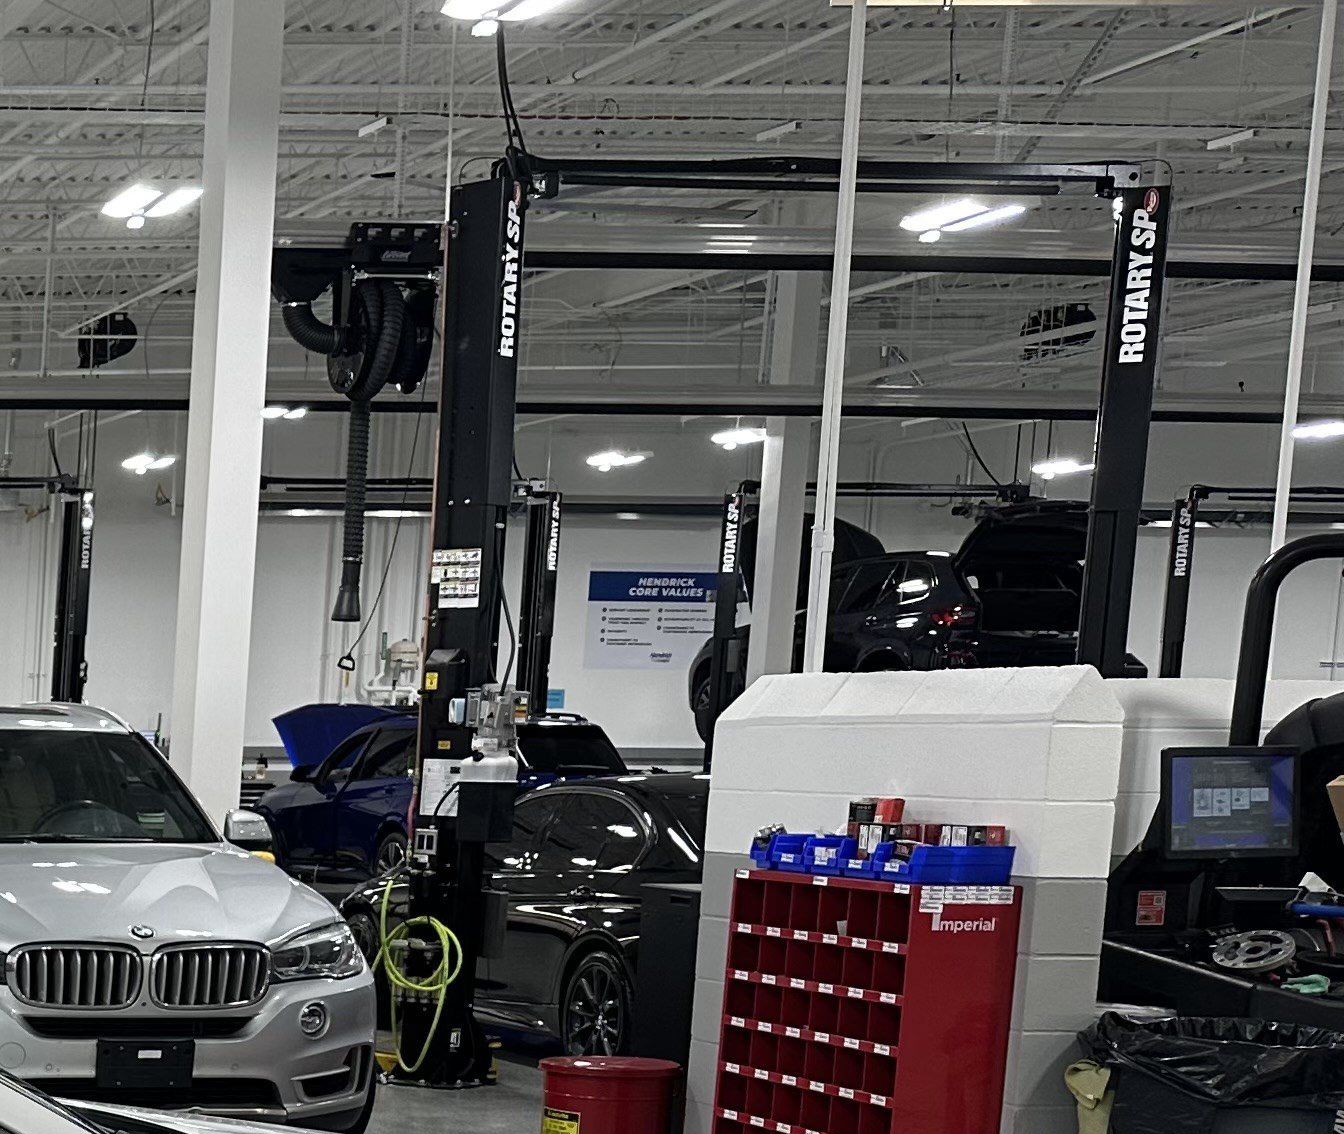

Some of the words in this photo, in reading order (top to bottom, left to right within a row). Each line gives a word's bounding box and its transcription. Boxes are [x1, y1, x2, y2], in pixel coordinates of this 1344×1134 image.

[507, 200, 520, 243] SP
[1131, 208, 1157, 249] SP
[500, 242, 518, 358] ROTARY
[1119, 251, 1154, 363] ROTARY
[727, 503, 739, 521] SP
[1179, 508, 1191, 526] SP
[548, 520, 559, 570] ROTARY
[722, 522, 738, 573] ROTARY
[1174, 526, 1190, 577] ROTARY
[629, 587, 660, 597] CORE
[662, 588, 704, 597] VALUES
[638, 578, 696, 587] HENDRICK
[931, 912, 996, 933] Imperial
